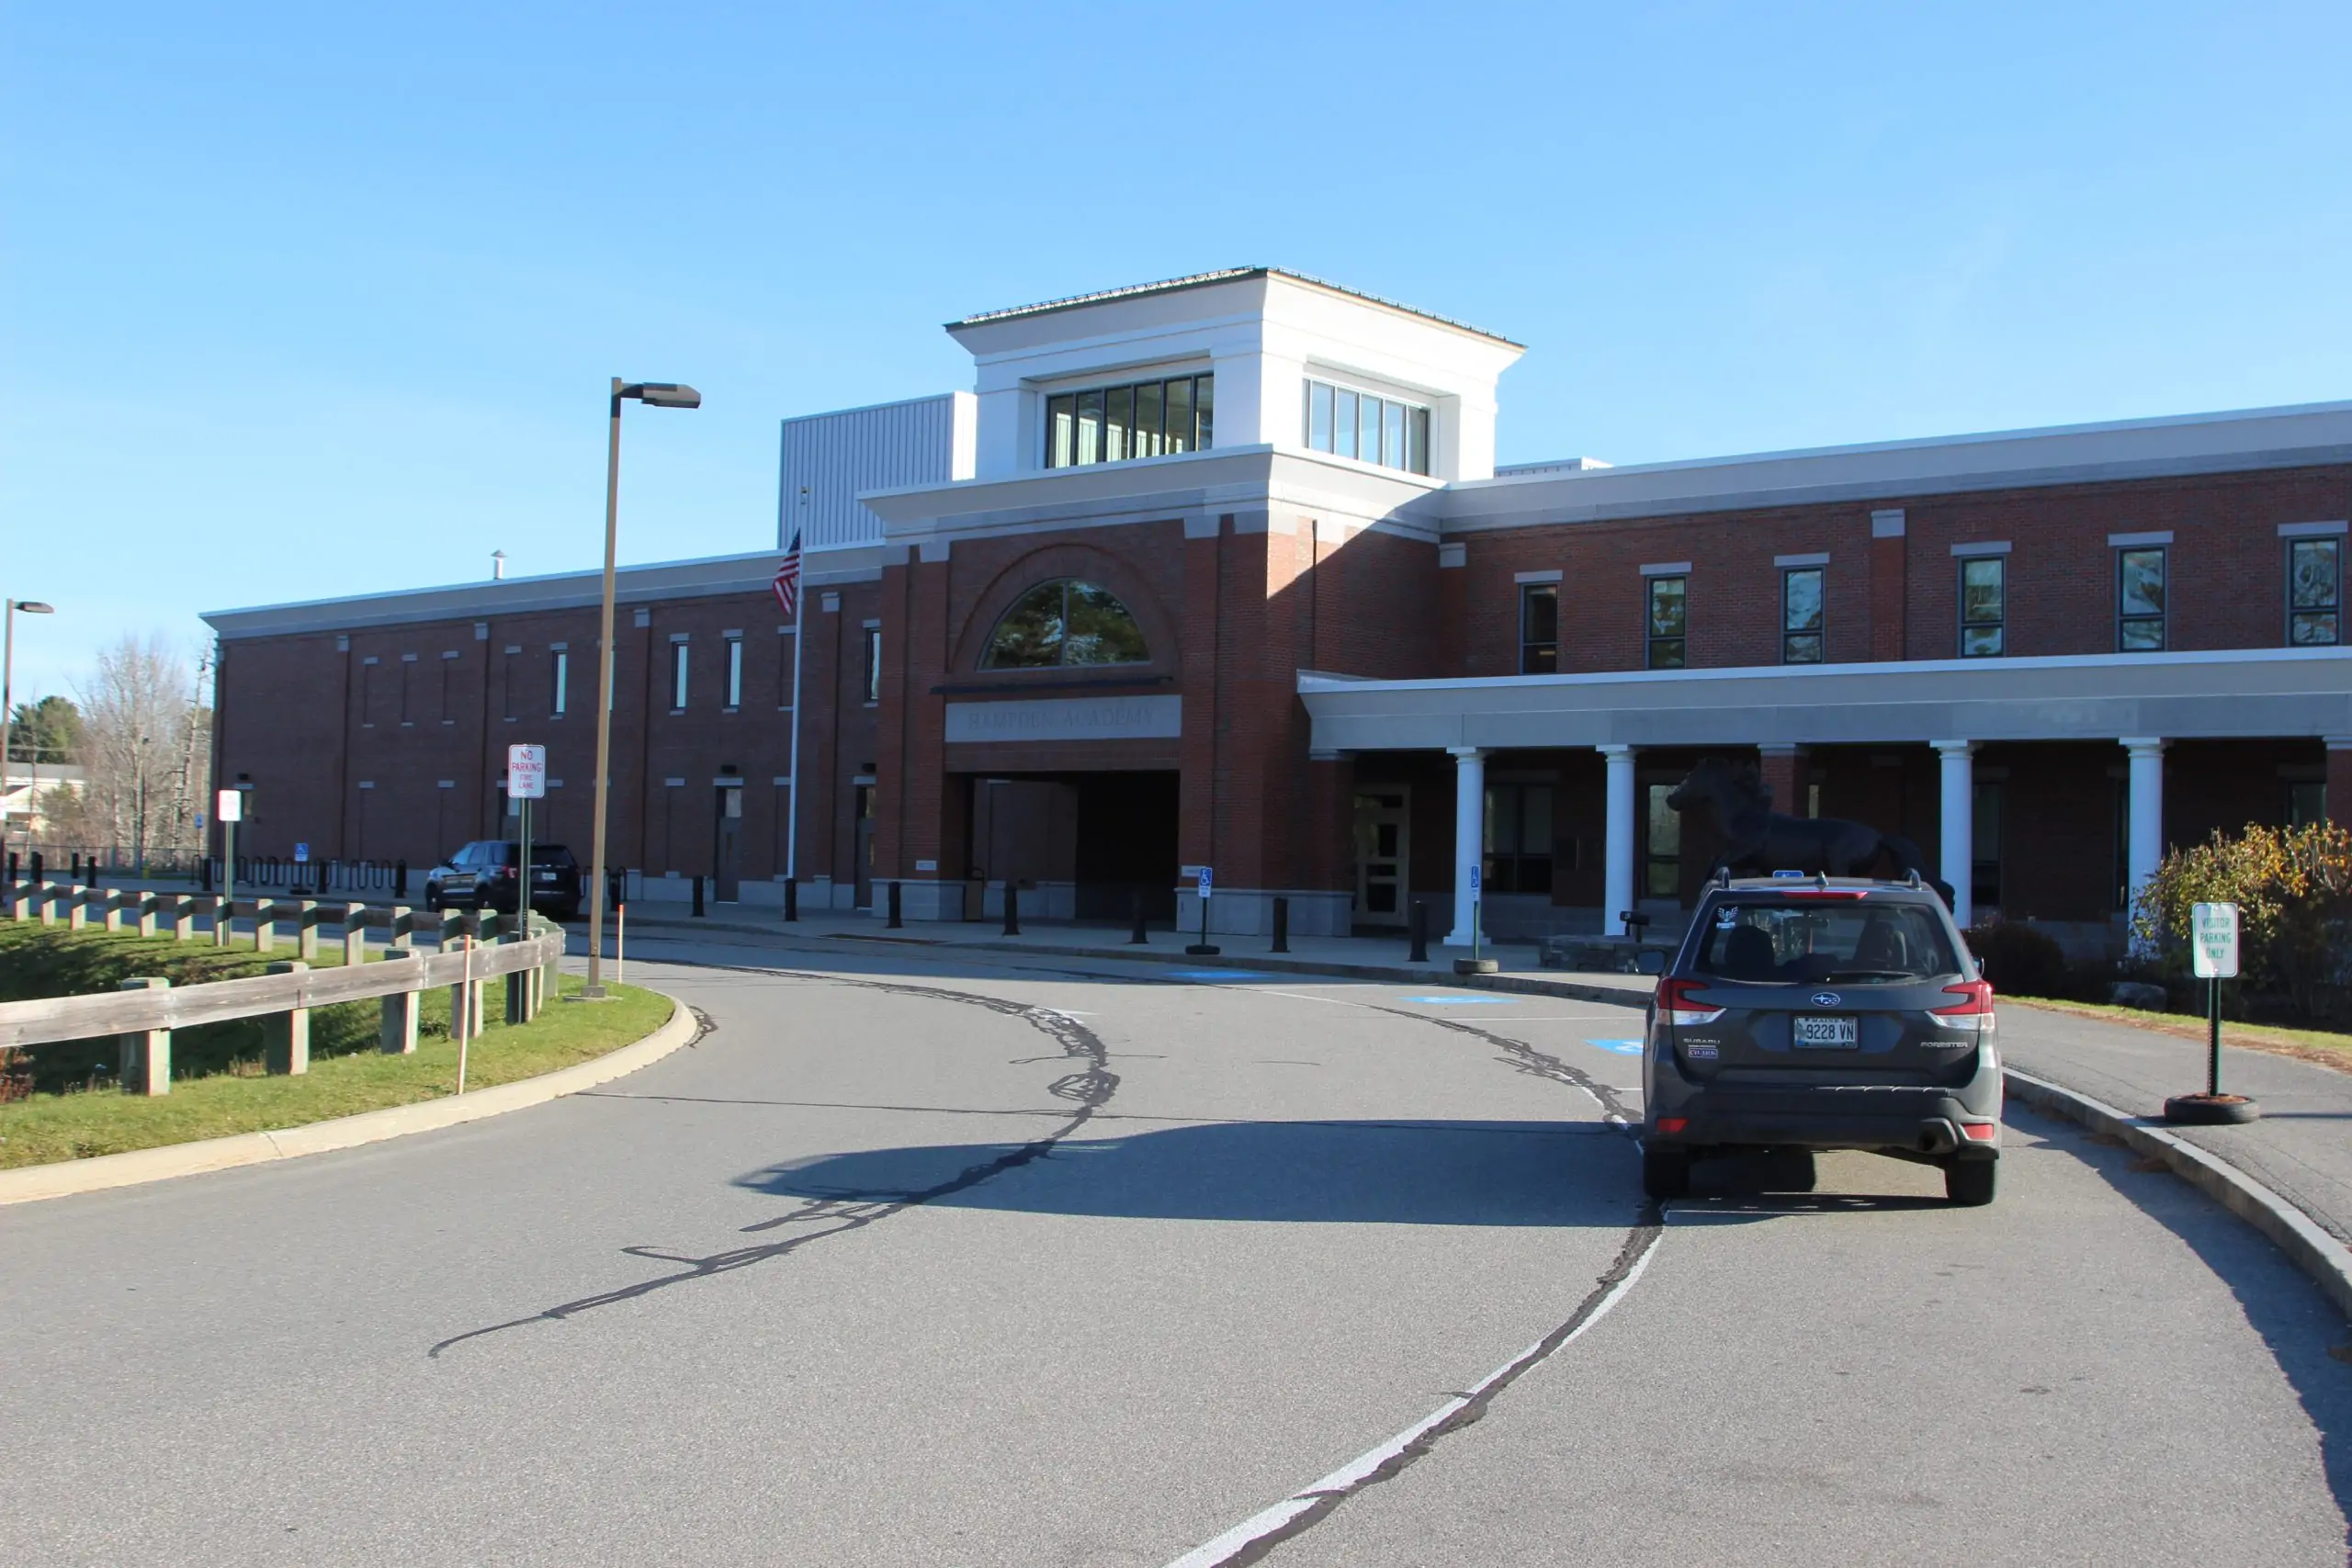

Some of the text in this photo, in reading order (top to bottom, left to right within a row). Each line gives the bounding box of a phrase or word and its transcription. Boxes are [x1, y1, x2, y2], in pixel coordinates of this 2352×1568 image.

[967, 706, 1154, 730] HAMPDEN ACADEMY
[520, 750, 533, 761] NO
[512, 762, 542, 773] PARKING
[2202, 917, 2231, 928] VISITOR
[2200, 932, 2231, 943] PARKING
[2206, 947, 2224, 959] ONLY
[1806, 1023, 1854, 1041] 9228 VN
